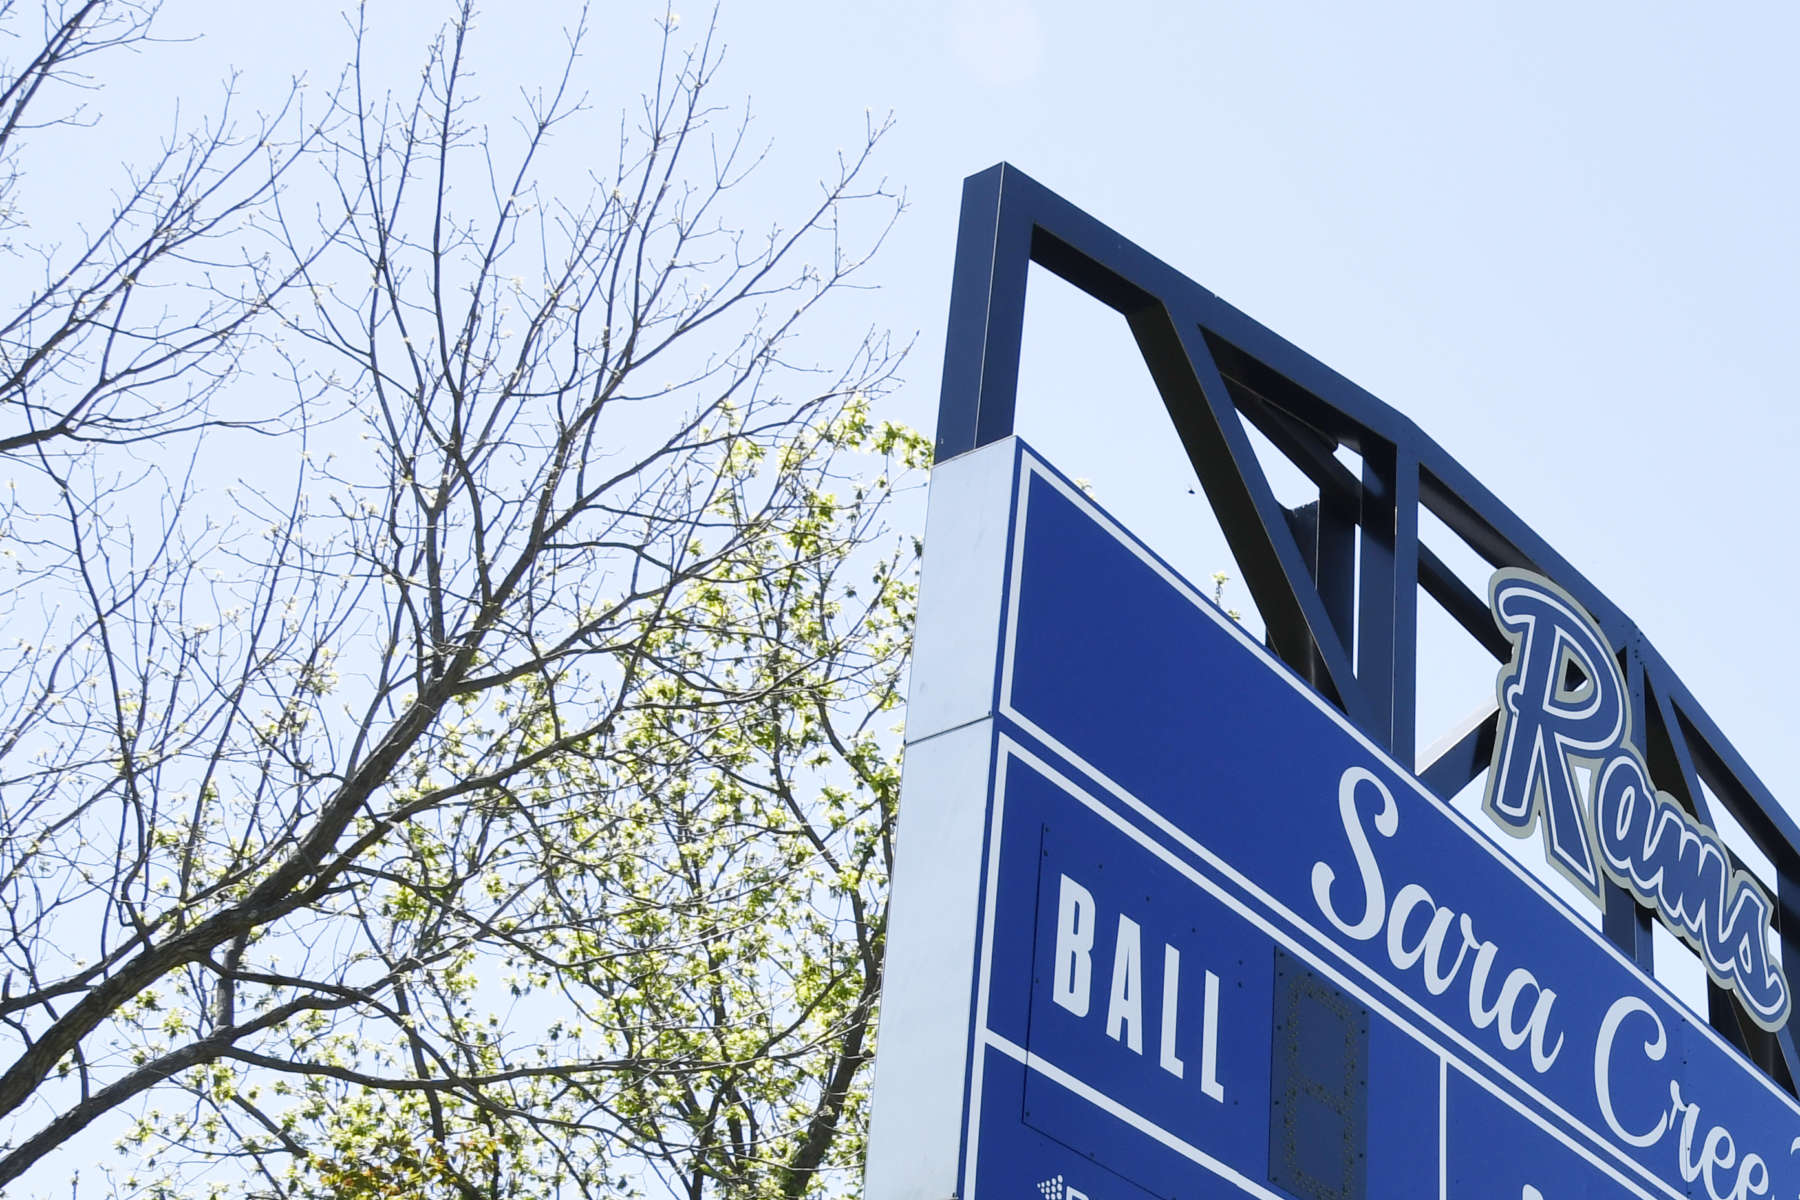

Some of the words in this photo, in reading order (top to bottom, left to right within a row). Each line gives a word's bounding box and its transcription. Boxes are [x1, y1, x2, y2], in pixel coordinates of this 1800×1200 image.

[1311, 766, 1564, 1074] Sara
[1481, 566, 1792, 1031] Rams
[1052, 873, 1224, 1104] BALL
